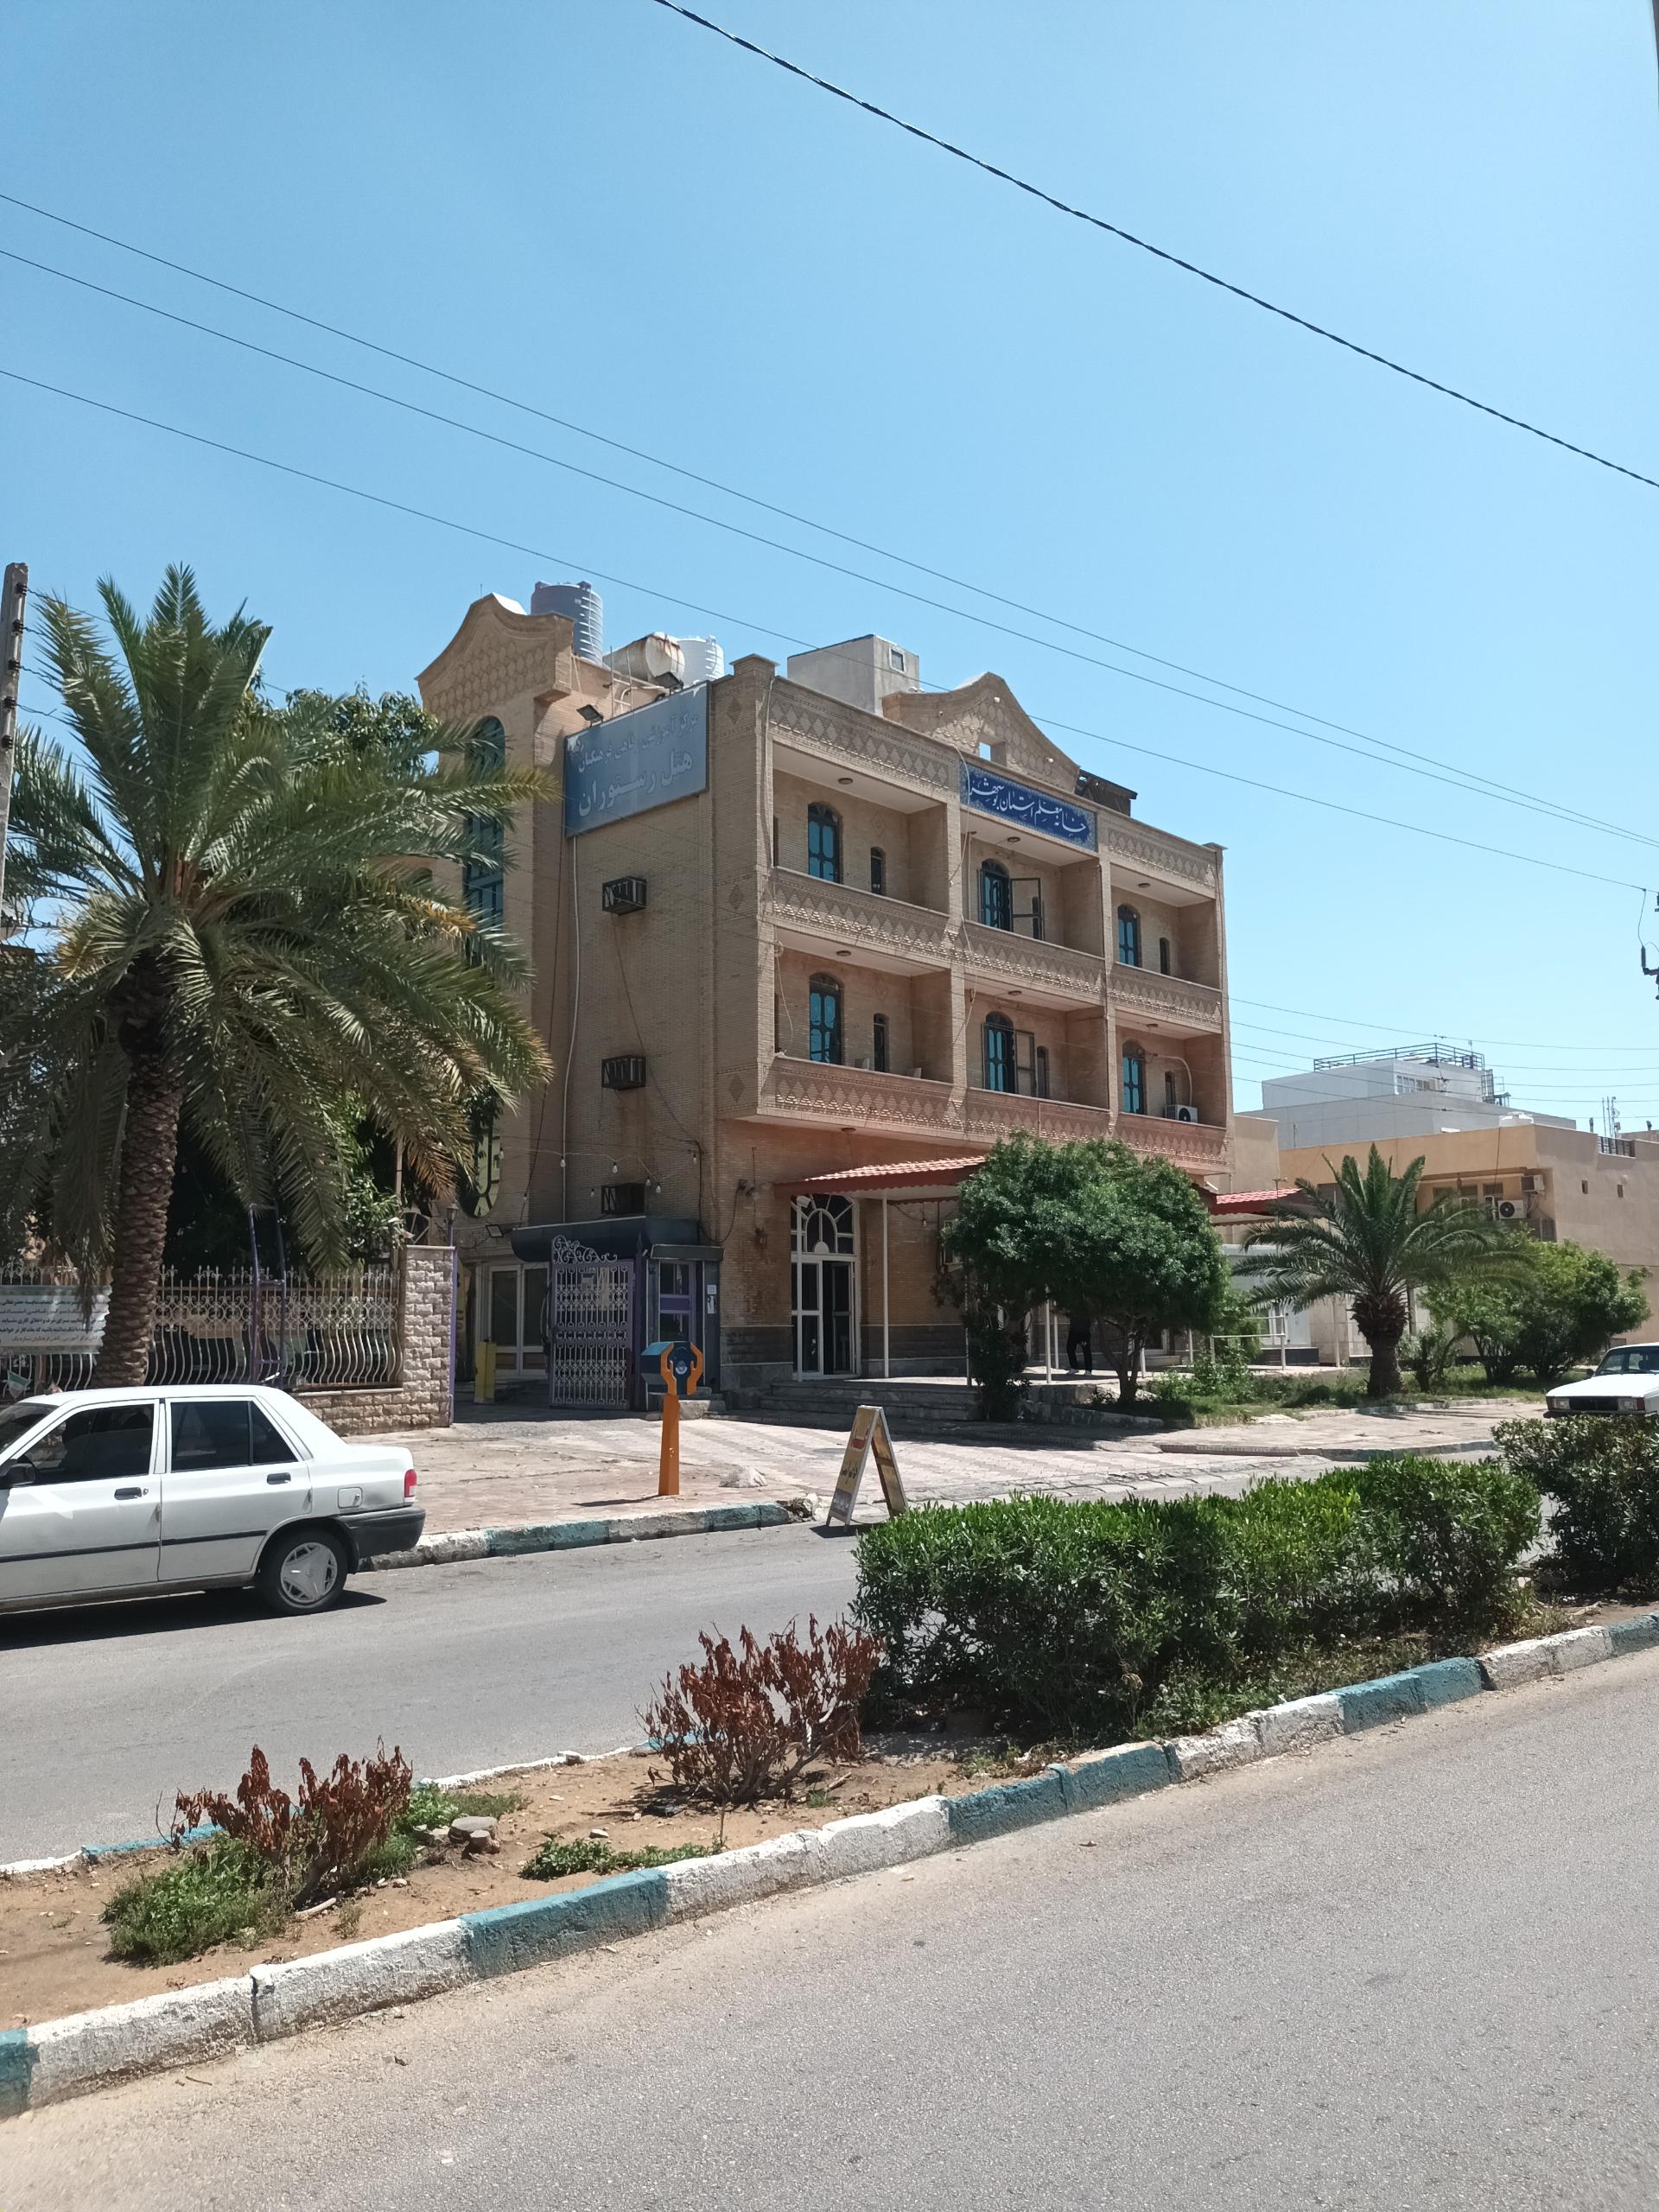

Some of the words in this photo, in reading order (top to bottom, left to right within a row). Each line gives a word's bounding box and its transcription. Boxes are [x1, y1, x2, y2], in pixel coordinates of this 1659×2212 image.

[678, 711, 699, 737] مرکز
[661, 747, 693, 787] هتل
[578, 770, 656, 817] رستوران
[969, 777, 1005, 810] بوشهر
[999, 791, 1035, 820] استان
[1034, 798, 1064, 826] معلم
[1054, 810, 1087, 836] خانه
